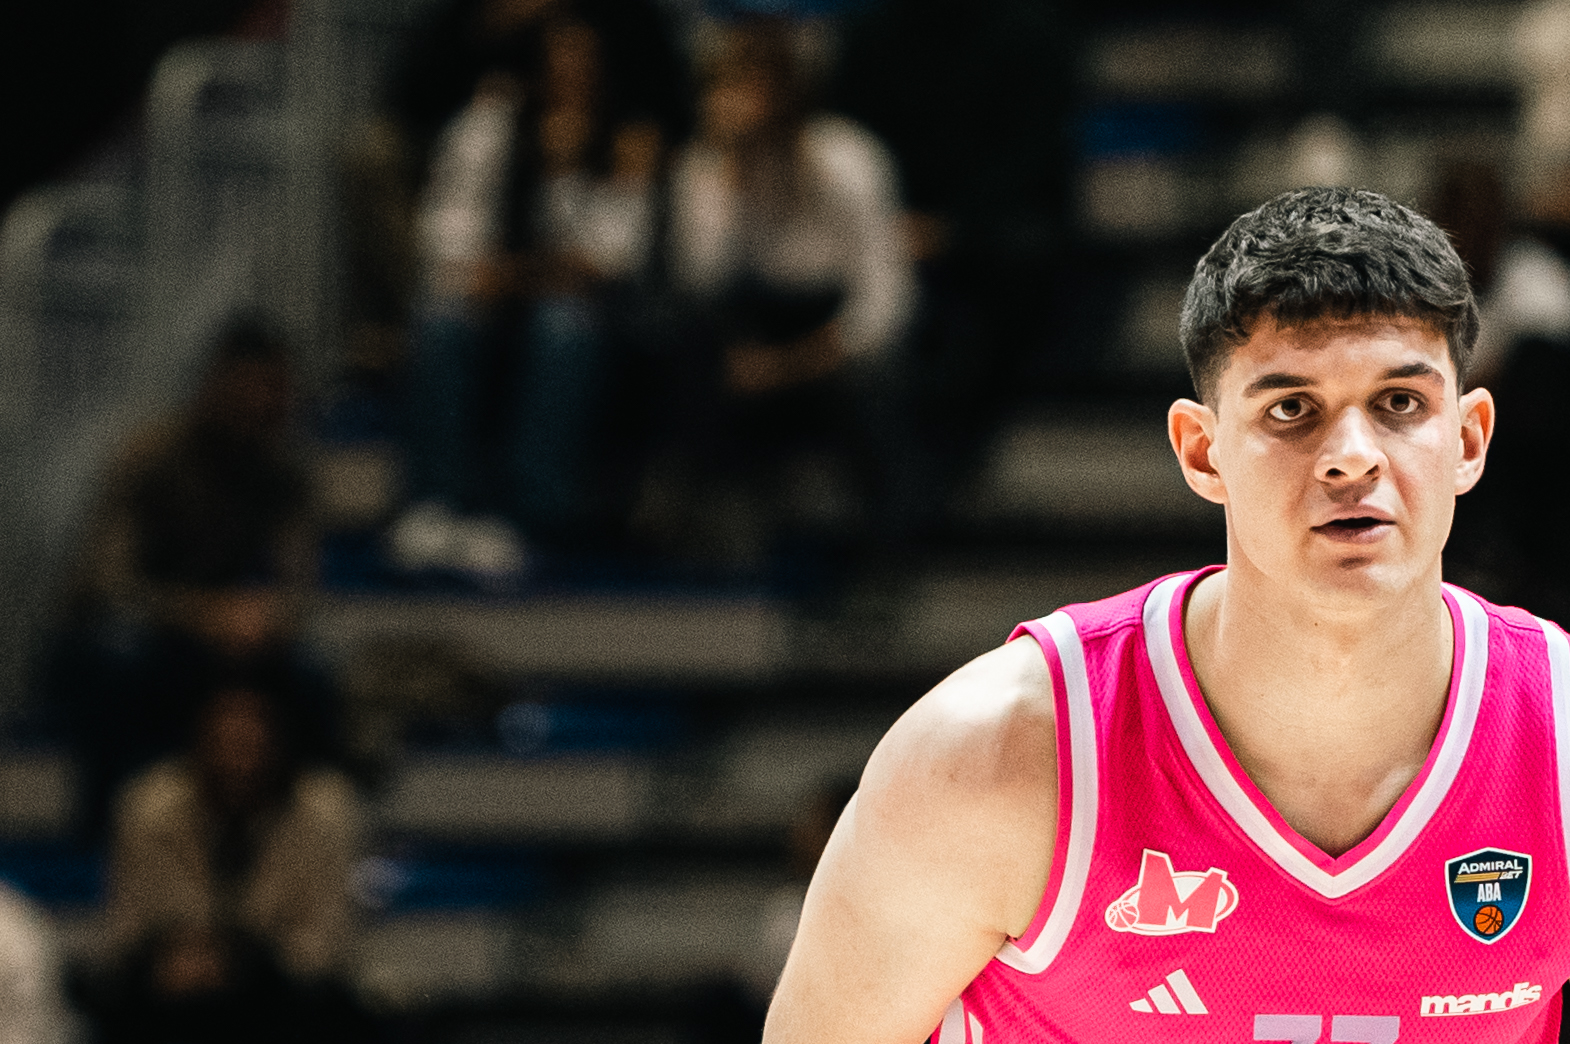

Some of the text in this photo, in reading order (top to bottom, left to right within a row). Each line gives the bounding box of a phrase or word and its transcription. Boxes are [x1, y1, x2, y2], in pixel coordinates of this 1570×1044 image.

[1458, 859, 1523, 874] ADMIRAL
[1499, 870, 1523, 880] BET
[1477, 882, 1502, 903] ABA
[1420, 981, 1543, 1015] mandis
